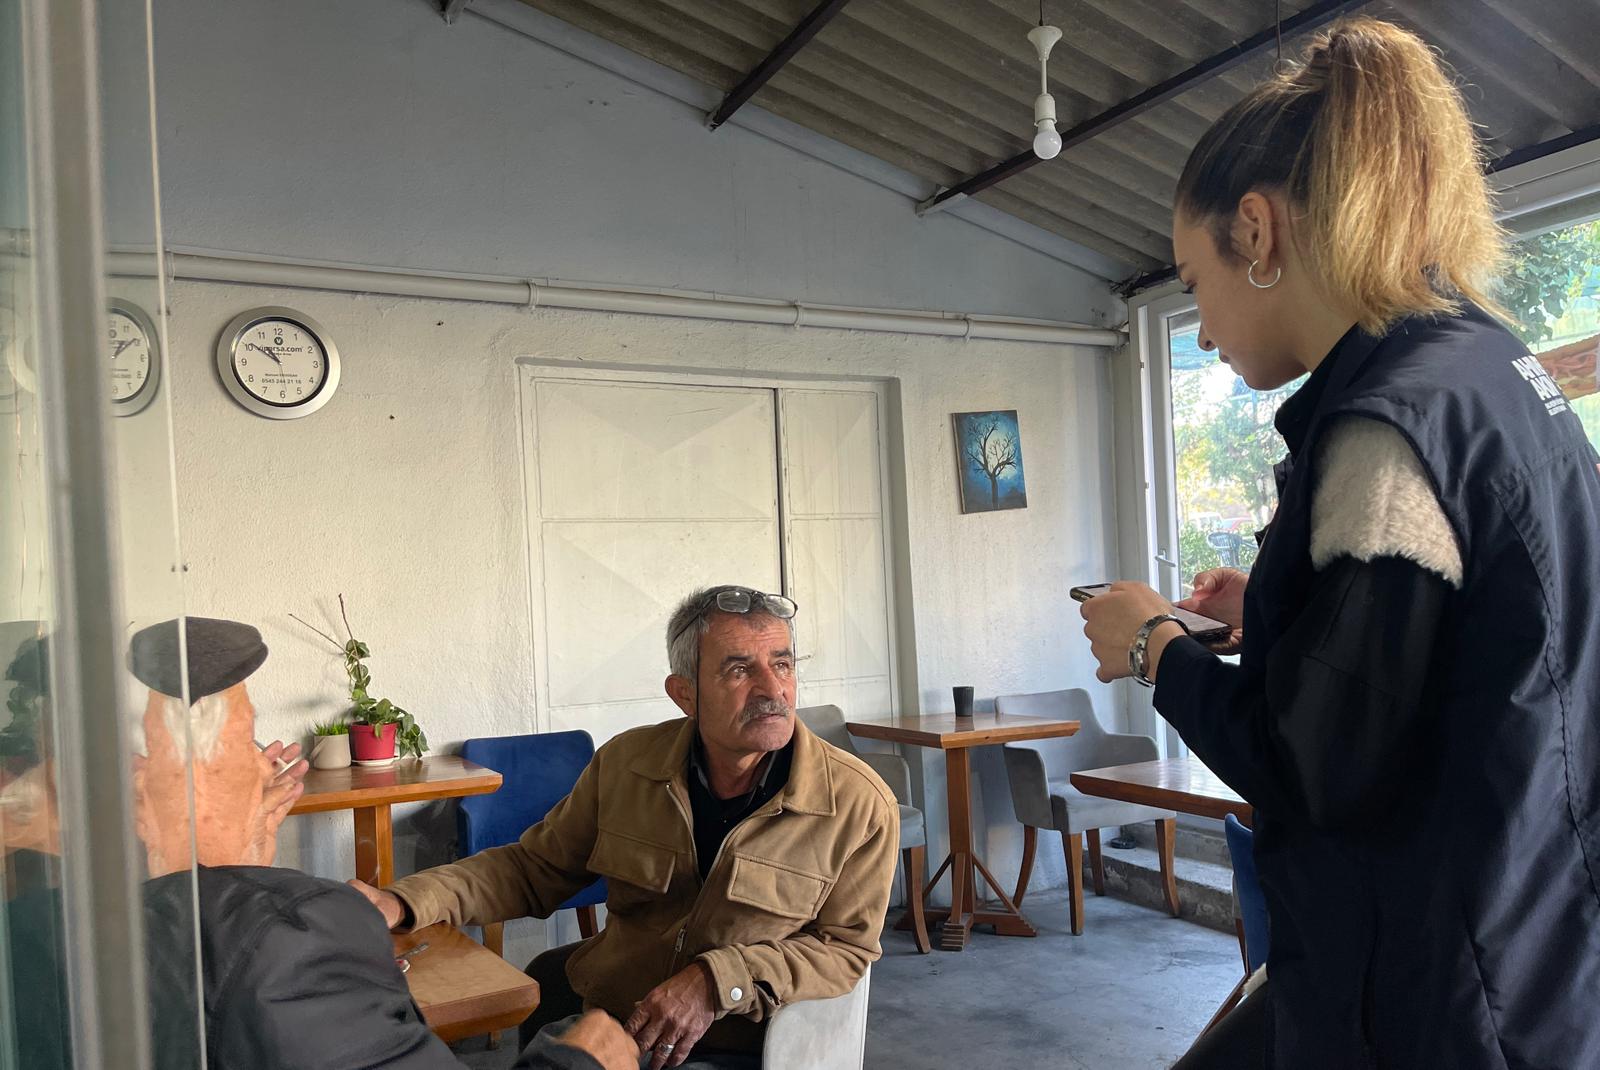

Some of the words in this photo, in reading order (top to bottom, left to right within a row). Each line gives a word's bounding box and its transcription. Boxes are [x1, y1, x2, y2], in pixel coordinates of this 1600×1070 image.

[257, 331, 266, 339] 11
[273, 328, 283, 336] 12
[245, 343, 254, 351] 10
